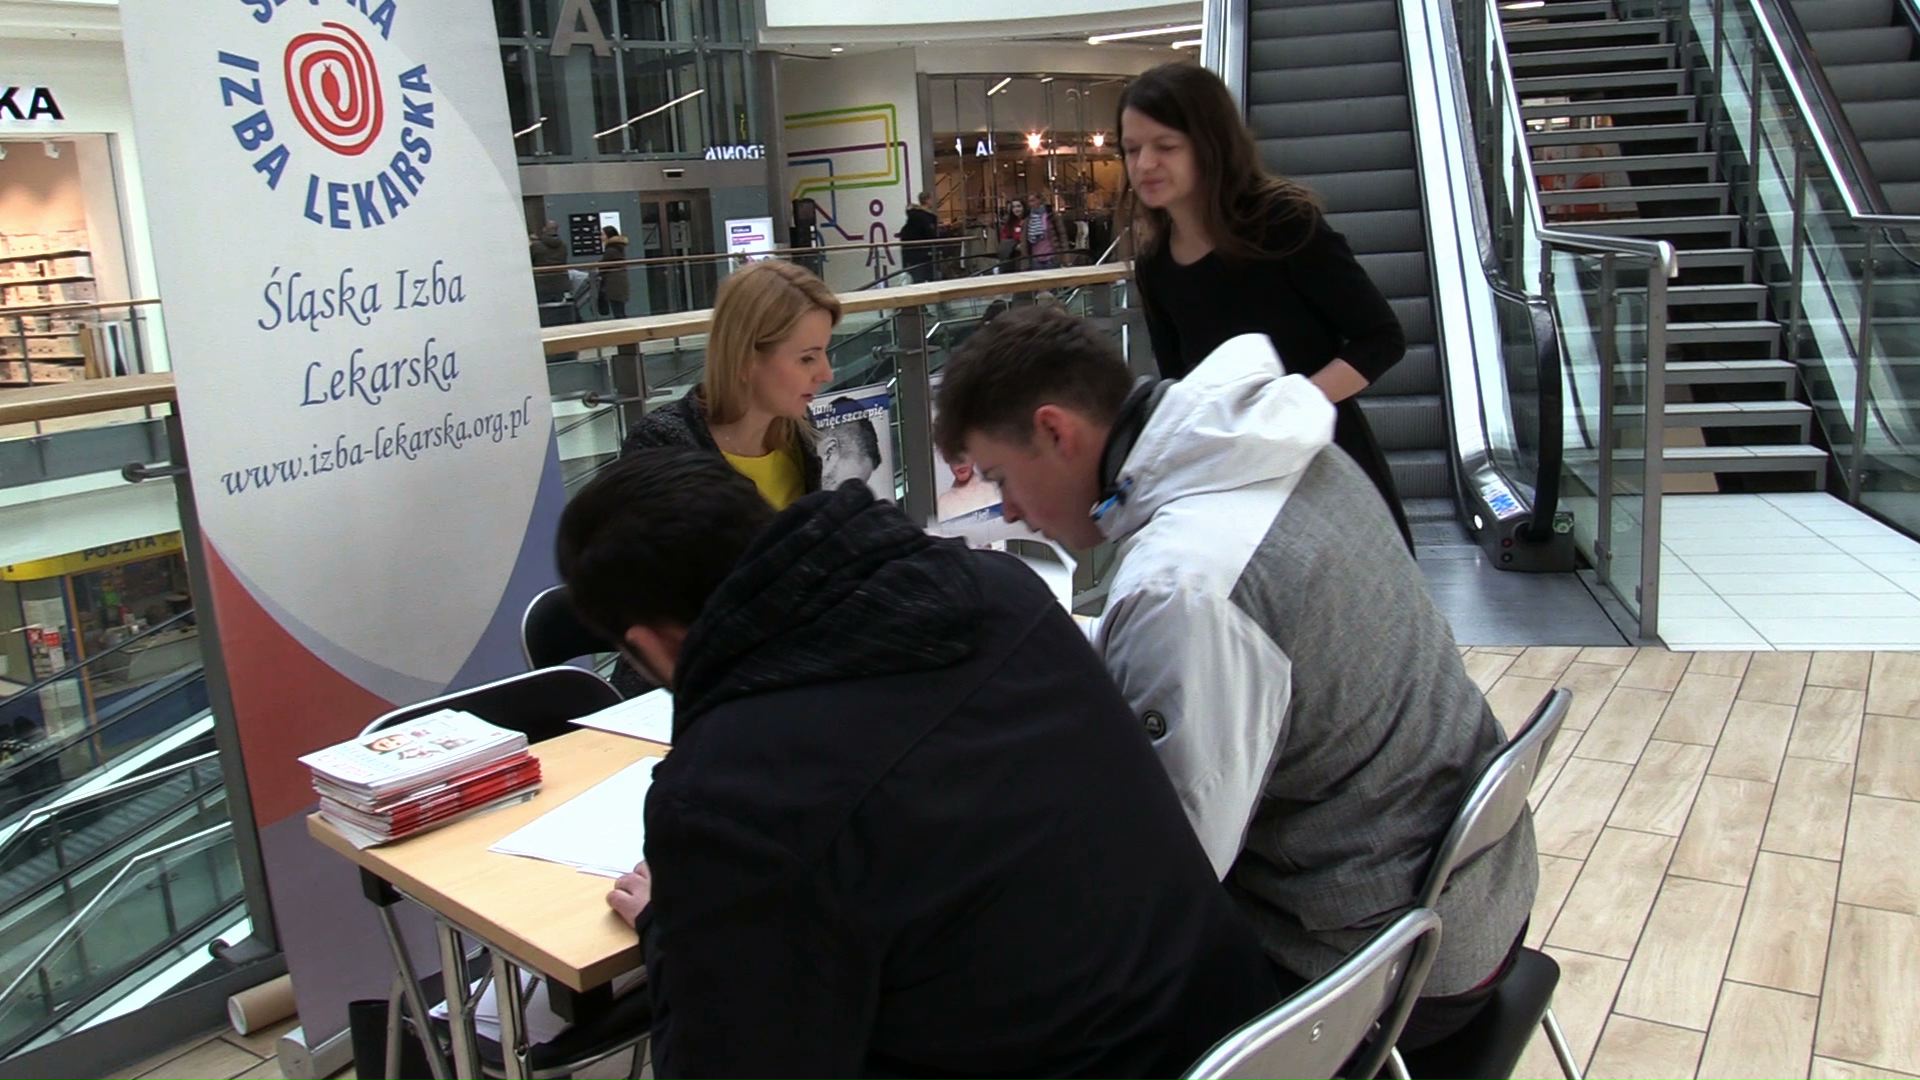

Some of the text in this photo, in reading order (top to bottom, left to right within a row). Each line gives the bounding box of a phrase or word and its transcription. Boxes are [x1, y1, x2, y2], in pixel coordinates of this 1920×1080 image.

[551, 0, 611, 56] A
[0, 87, 65, 120] KA
[218, 51, 435, 229] IZBA LEKARSKA
[258, 260, 466, 332] Śląska Izba
[300, 338, 459, 407] Lekarska
[221, 396, 533, 496] www.izba-lekarska.org.pl
[816, 403, 885, 429] więc szczepię
